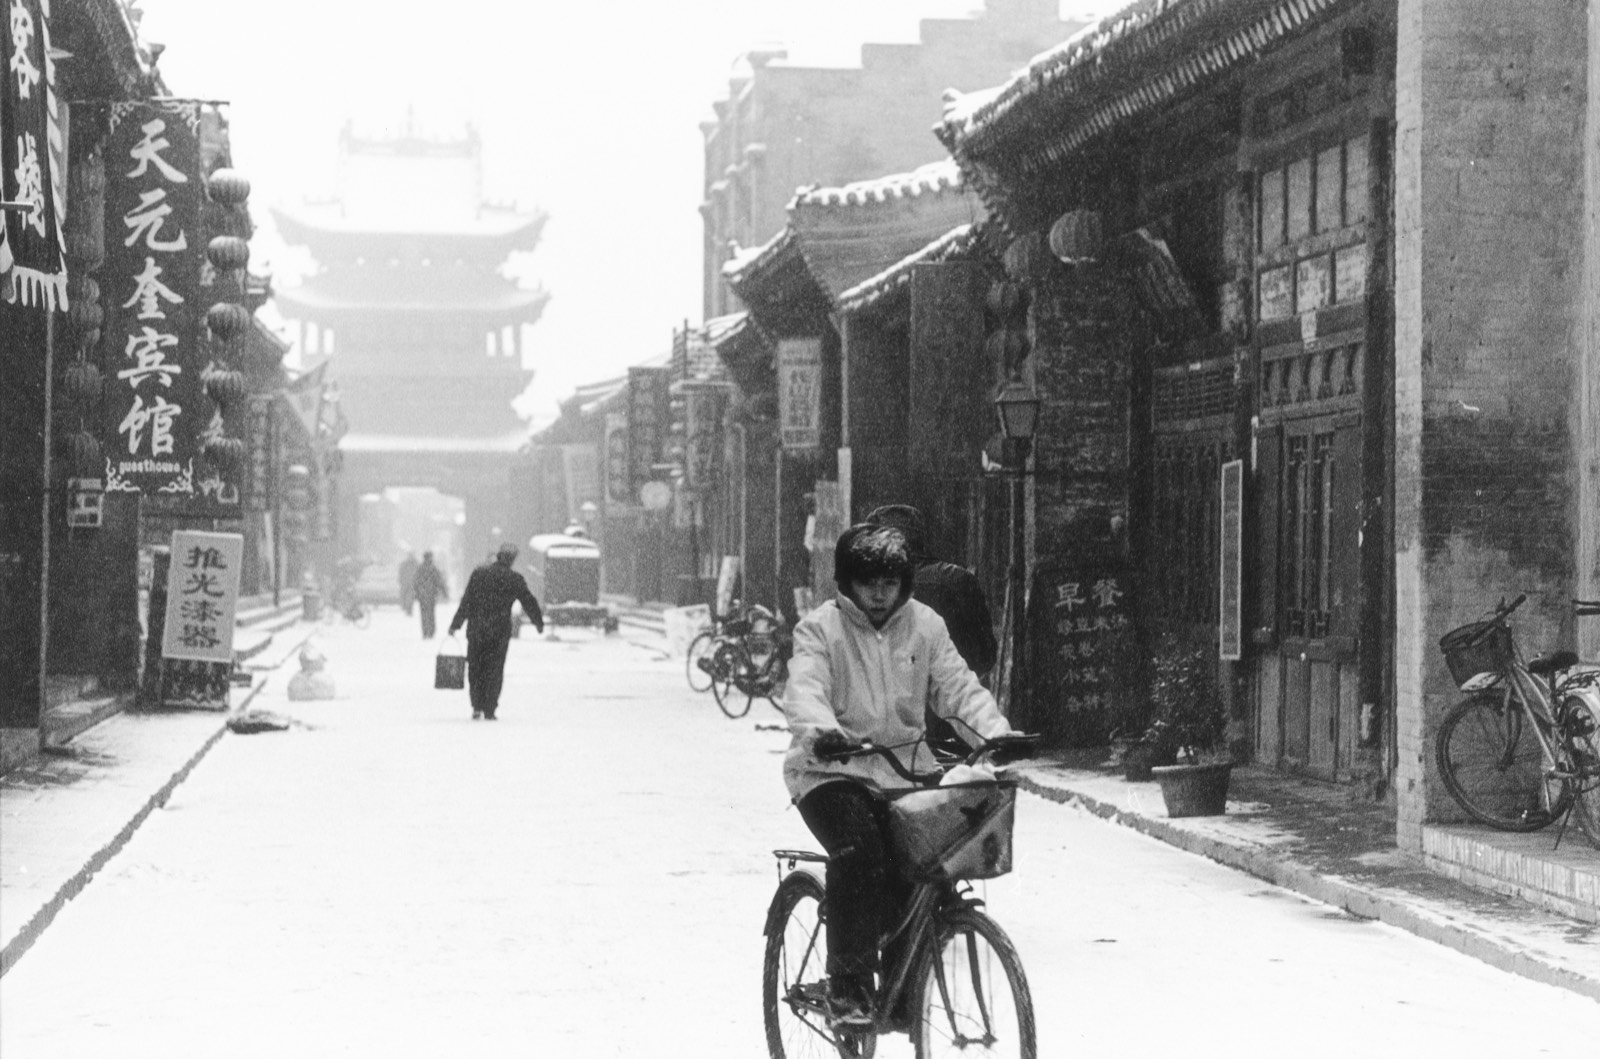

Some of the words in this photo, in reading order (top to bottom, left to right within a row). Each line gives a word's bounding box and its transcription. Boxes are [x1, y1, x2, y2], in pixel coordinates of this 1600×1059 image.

[117, 117, 189, 457] 天元奎宾馆
[177, 545, 228, 649] 推光漆器
[1055, 578, 1124, 612] 早餐
